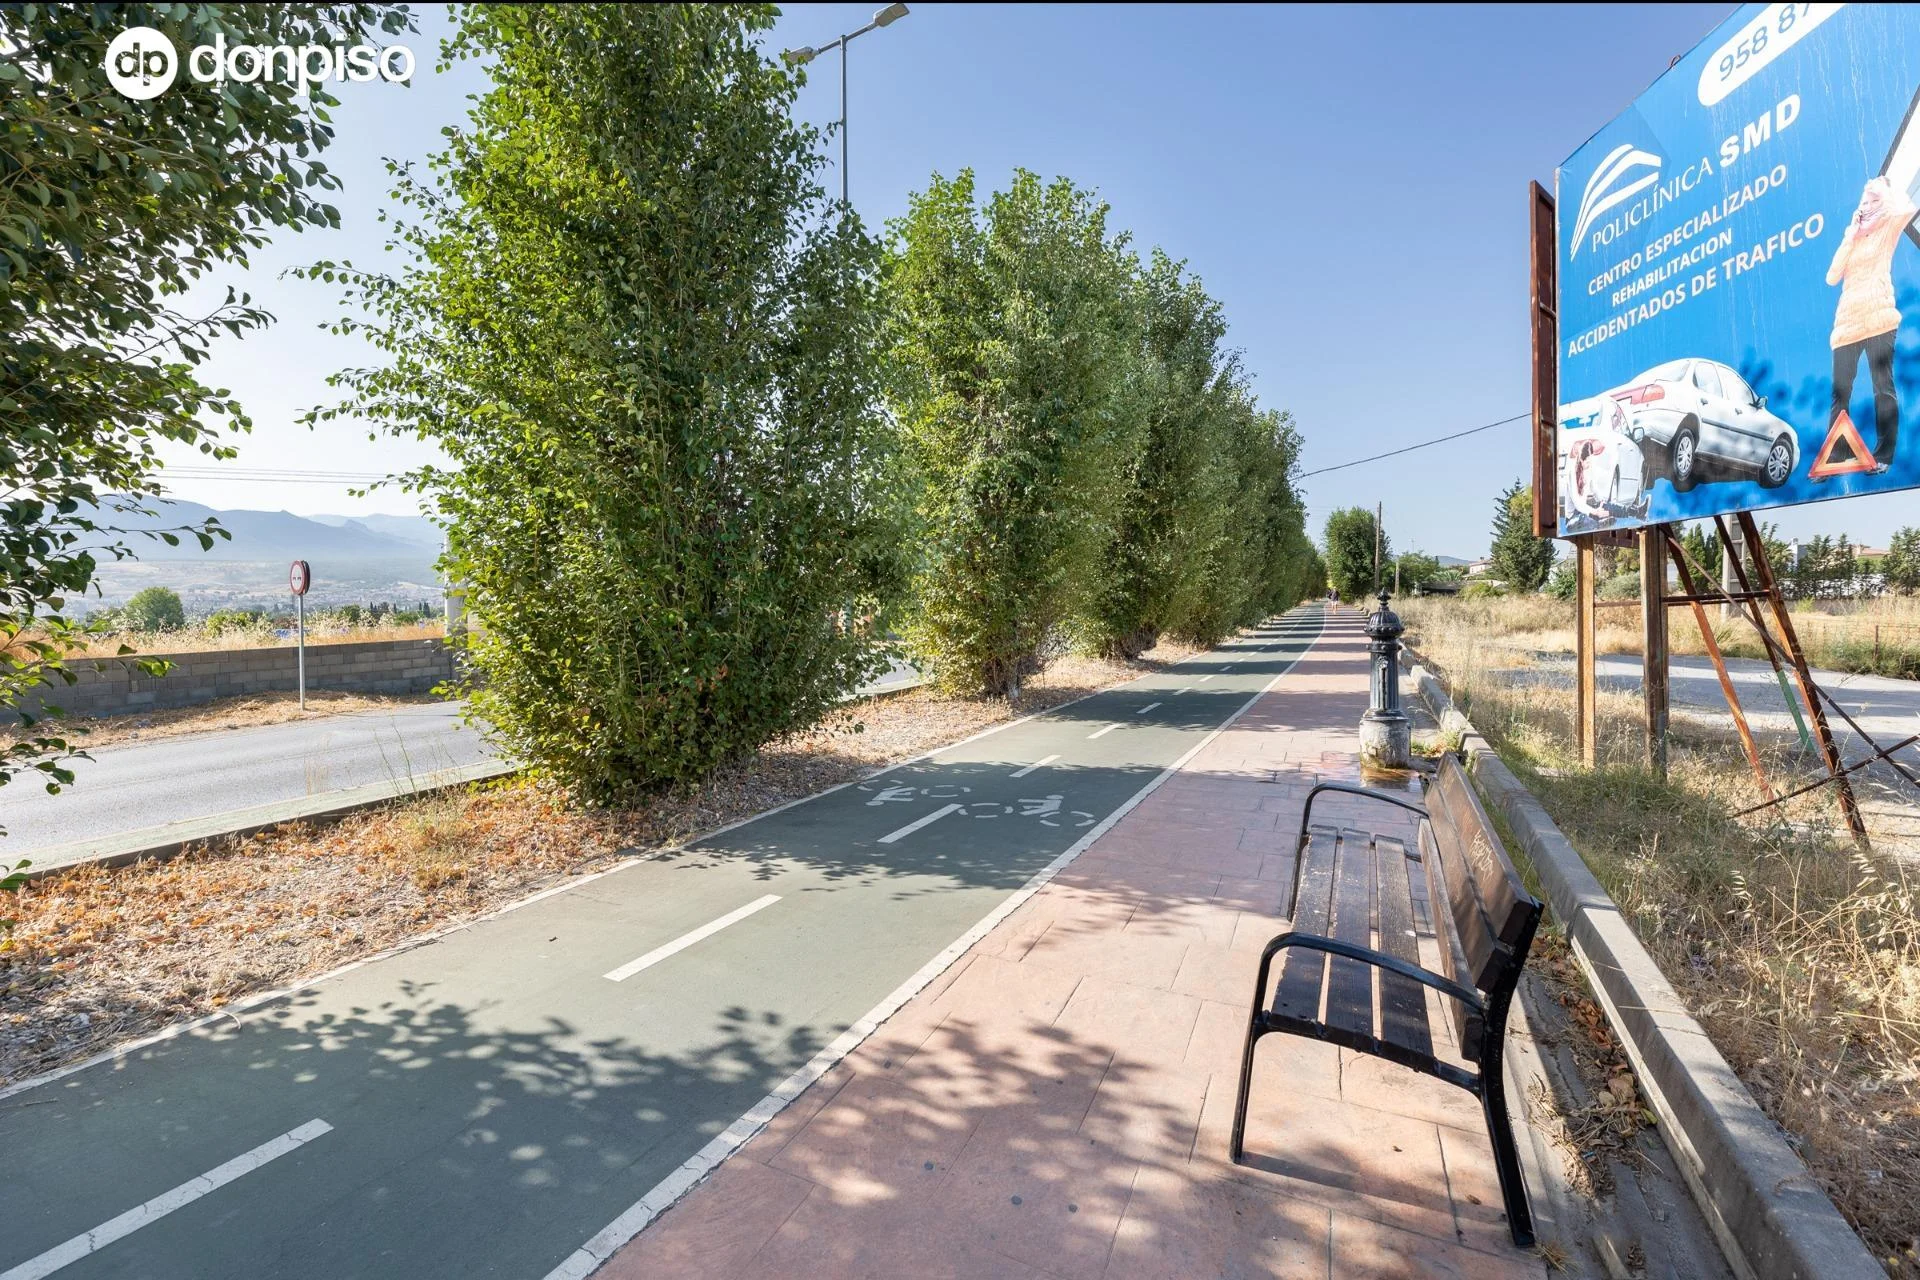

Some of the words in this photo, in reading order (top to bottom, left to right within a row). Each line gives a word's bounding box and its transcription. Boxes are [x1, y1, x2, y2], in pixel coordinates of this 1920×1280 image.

[1718, 26, 1768, 82] 958
[1587, 252, 1642, 296] CENTRO
[1645, 164, 1787, 262] ESPECIALIZADO
[1591, 157, 1713, 253] POLICLÍNICA
[1719, 94, 1801, 168] SMD
[1568, 283, 1686, 358] ACCIDENTADOS
[1691, 268, 1717, 297] DE
[1721, 213, 1824, 281] TRAFICO
[1612, 228, 1733, 307] REHABILITACION
